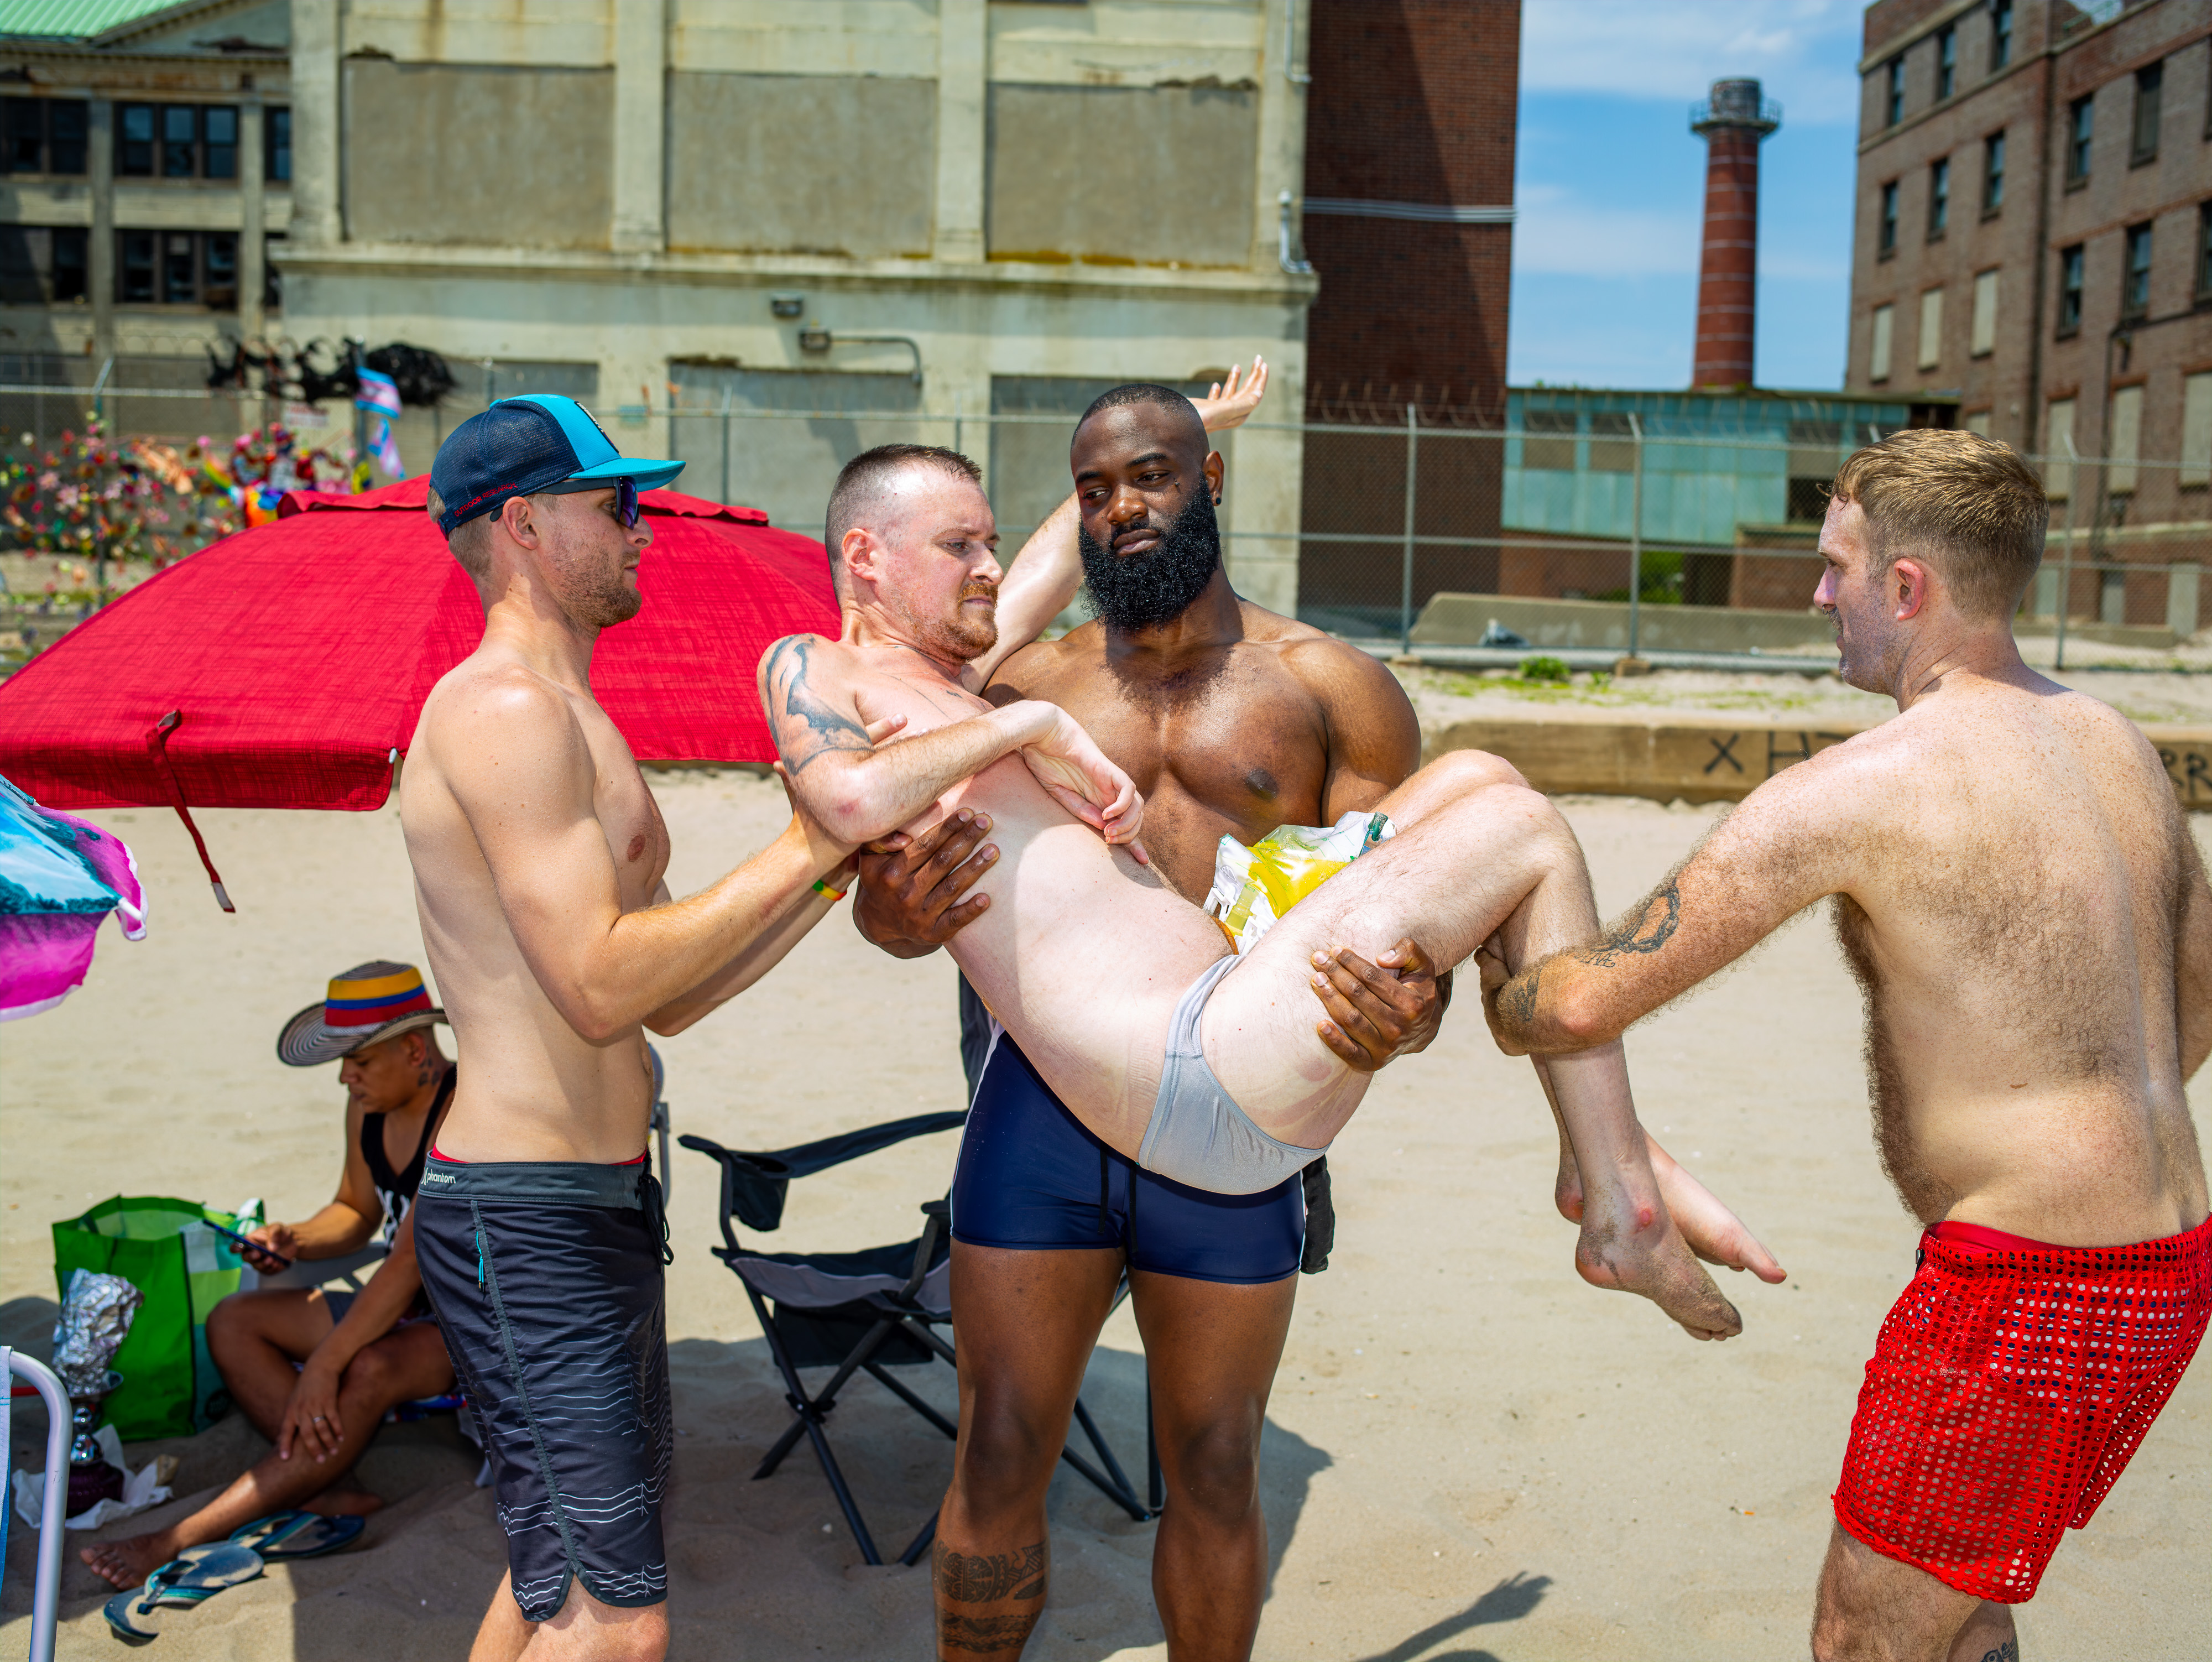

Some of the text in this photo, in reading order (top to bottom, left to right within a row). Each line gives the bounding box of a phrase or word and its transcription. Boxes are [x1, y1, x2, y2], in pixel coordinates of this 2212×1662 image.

[454, 482, 518, 517] OUTDOOR RESEARCH
[1265, 865, 1276, 876] 3750
[426, 1168, 456, 1184] phantom
